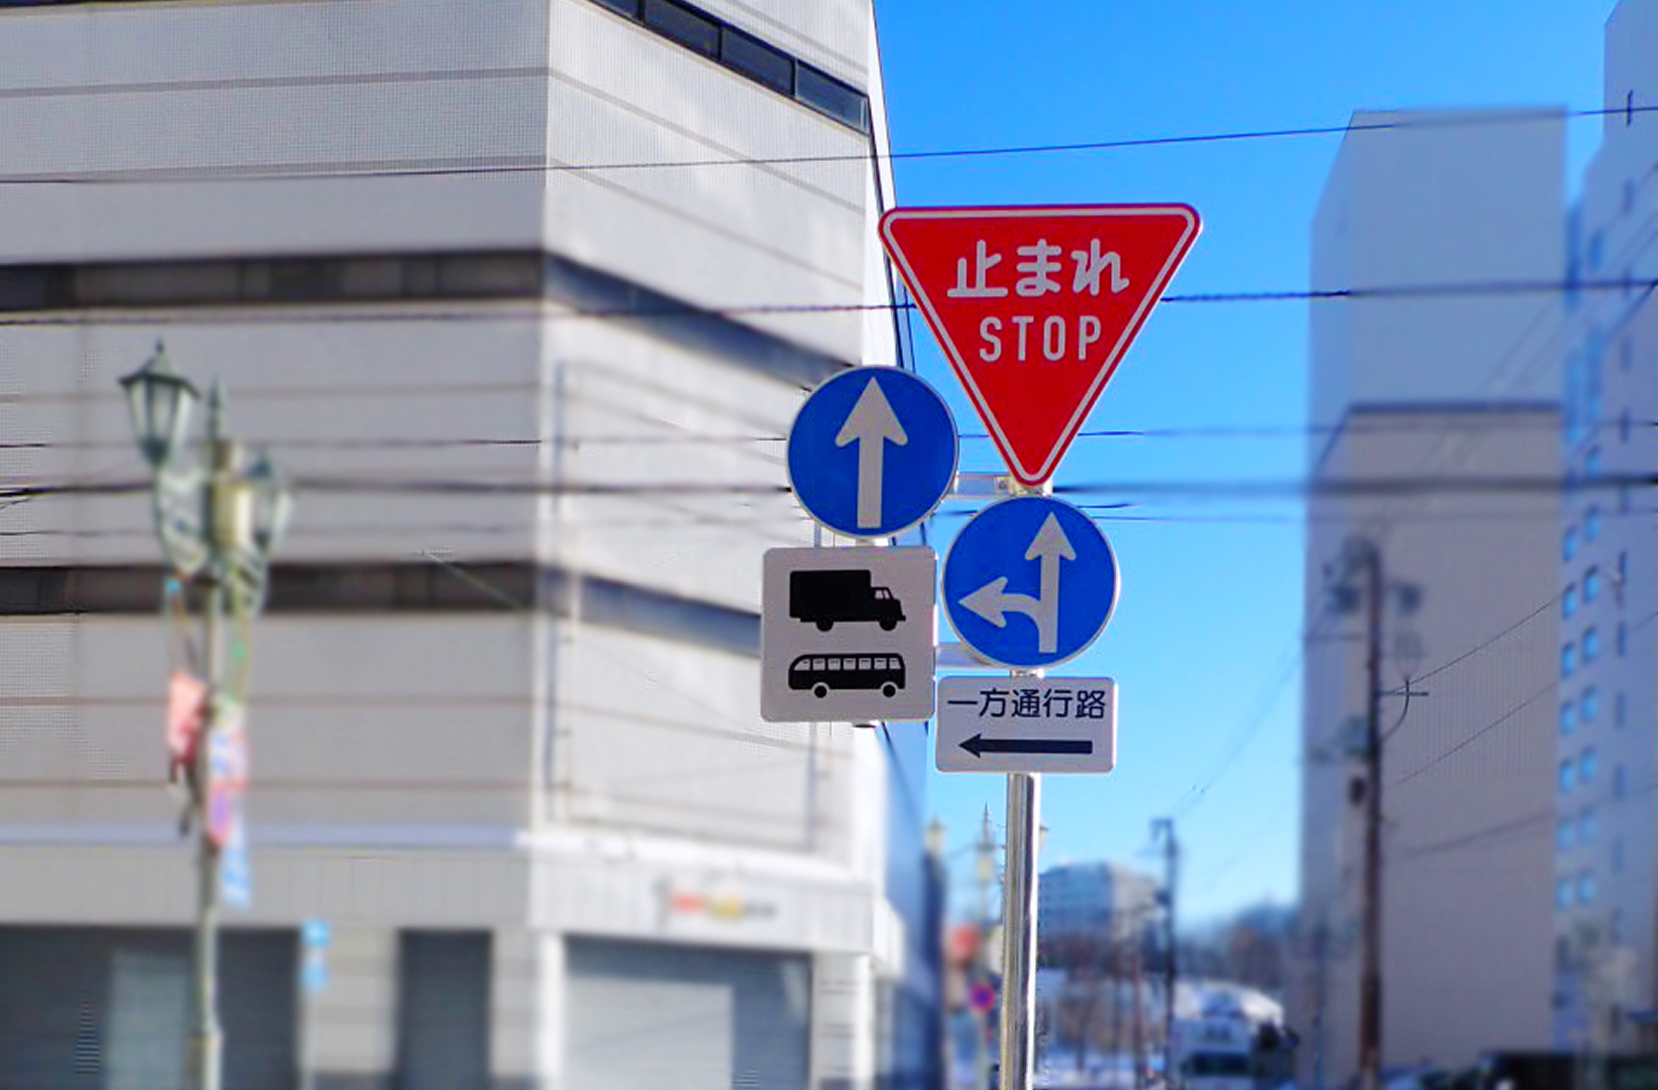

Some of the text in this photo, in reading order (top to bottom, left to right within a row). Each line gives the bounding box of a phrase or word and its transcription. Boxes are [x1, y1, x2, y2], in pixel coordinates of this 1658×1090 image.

[947, 238, 1130, 298] 止まれ
[979, 316, 1102, 361] STOP
[947, 687, 1106, 719] 一方通行路
